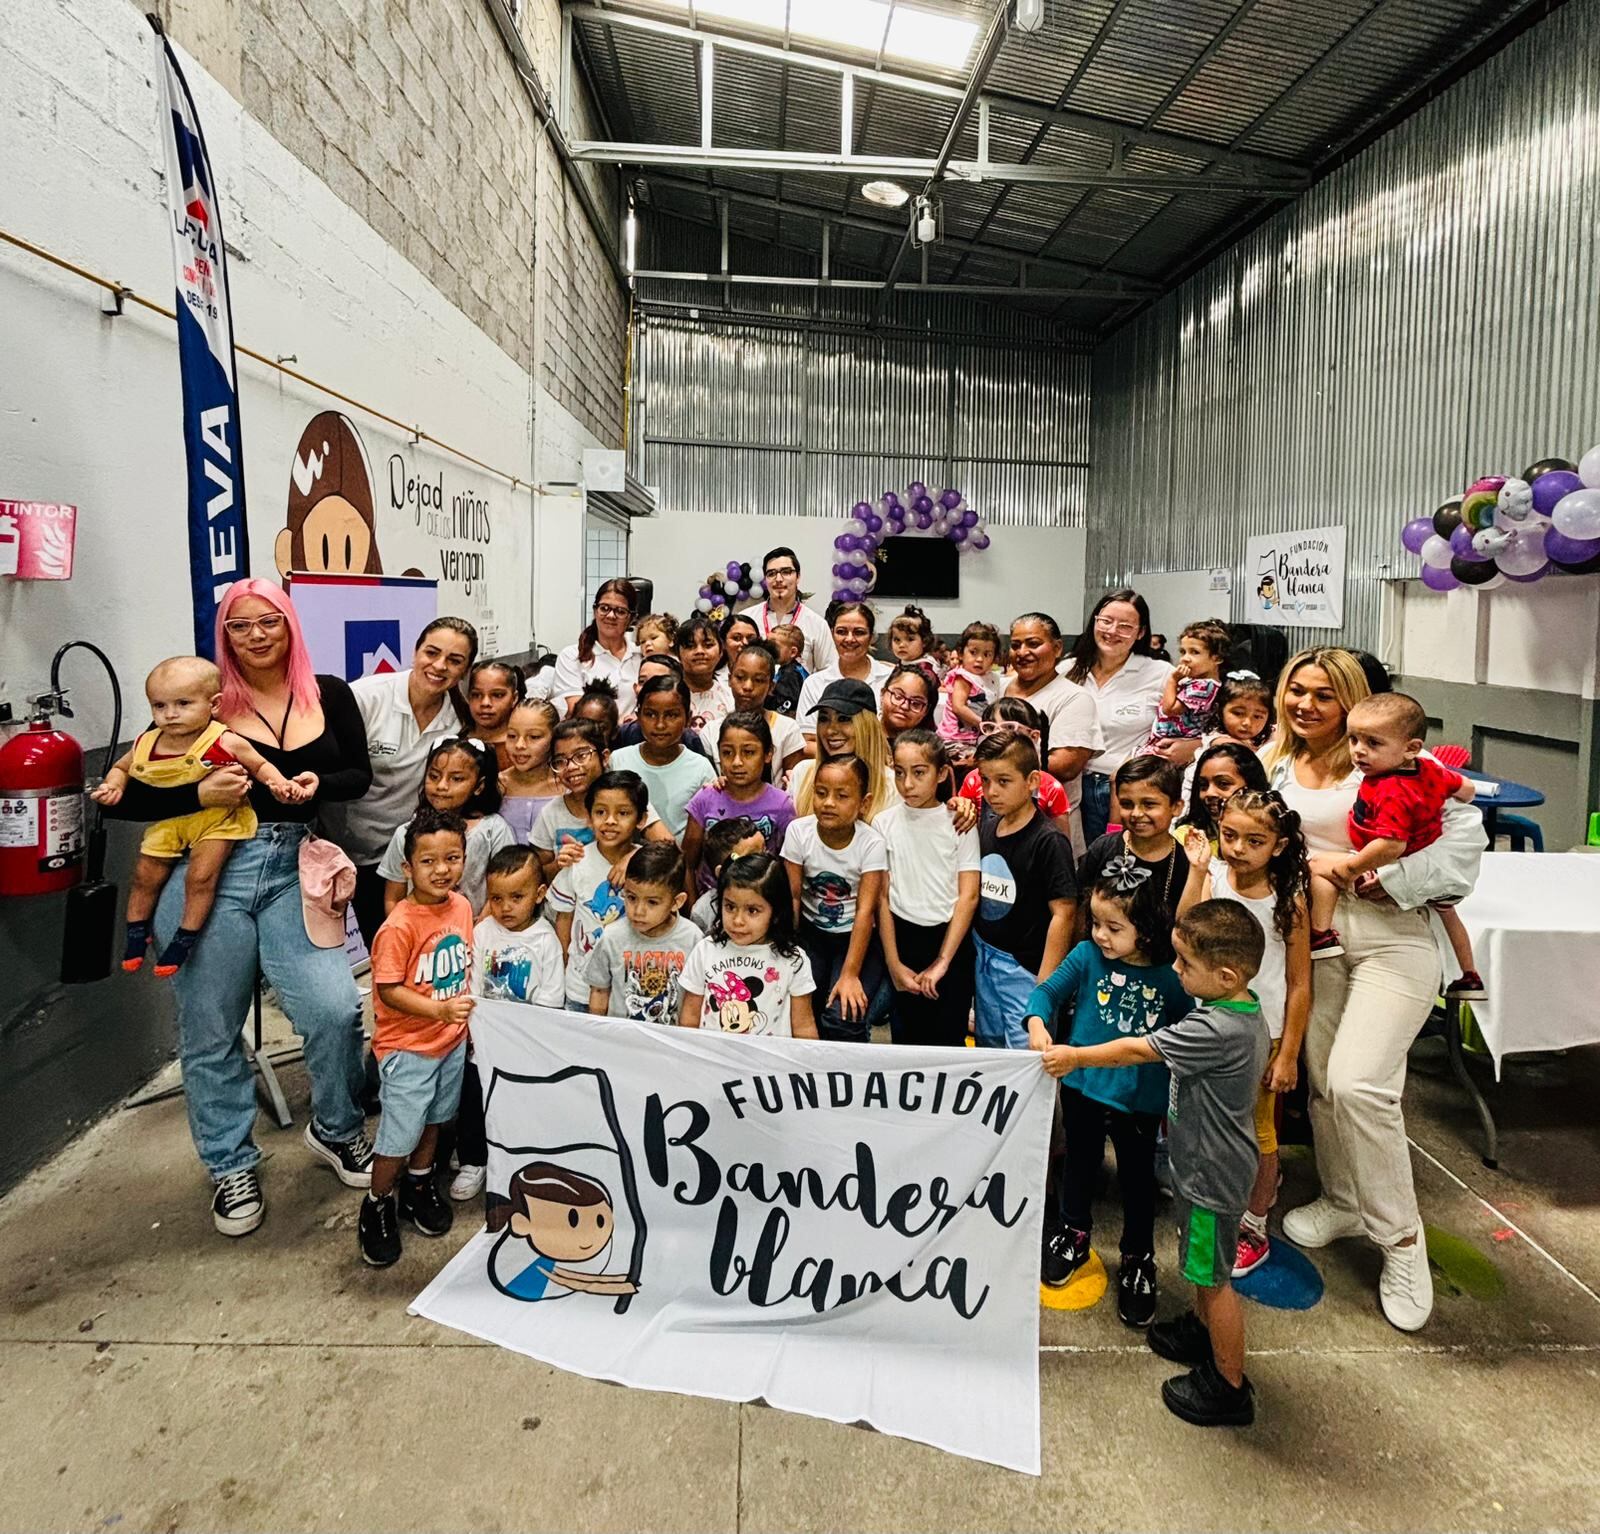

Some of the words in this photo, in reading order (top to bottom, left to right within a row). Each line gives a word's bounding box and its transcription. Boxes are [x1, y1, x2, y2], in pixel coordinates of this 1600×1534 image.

[387, 454, 443, 527] Dejad
[0, 502, 73, 519] TINTOR
[452, 490, 491, 544] niños
[1289, 539, 1329, 555] FUNDACIÓN
[440, 549, 485, 596] vengan
[1278, 553, 1331, 580] Bandera
[1286, 577, 1326, 596] blanca
[711, 956, 766, 976] RAINBOWS
[722, 1071, 1019, 1136] FUNDACIÓN
[643, 1092, 1029, 1238] Bandera
